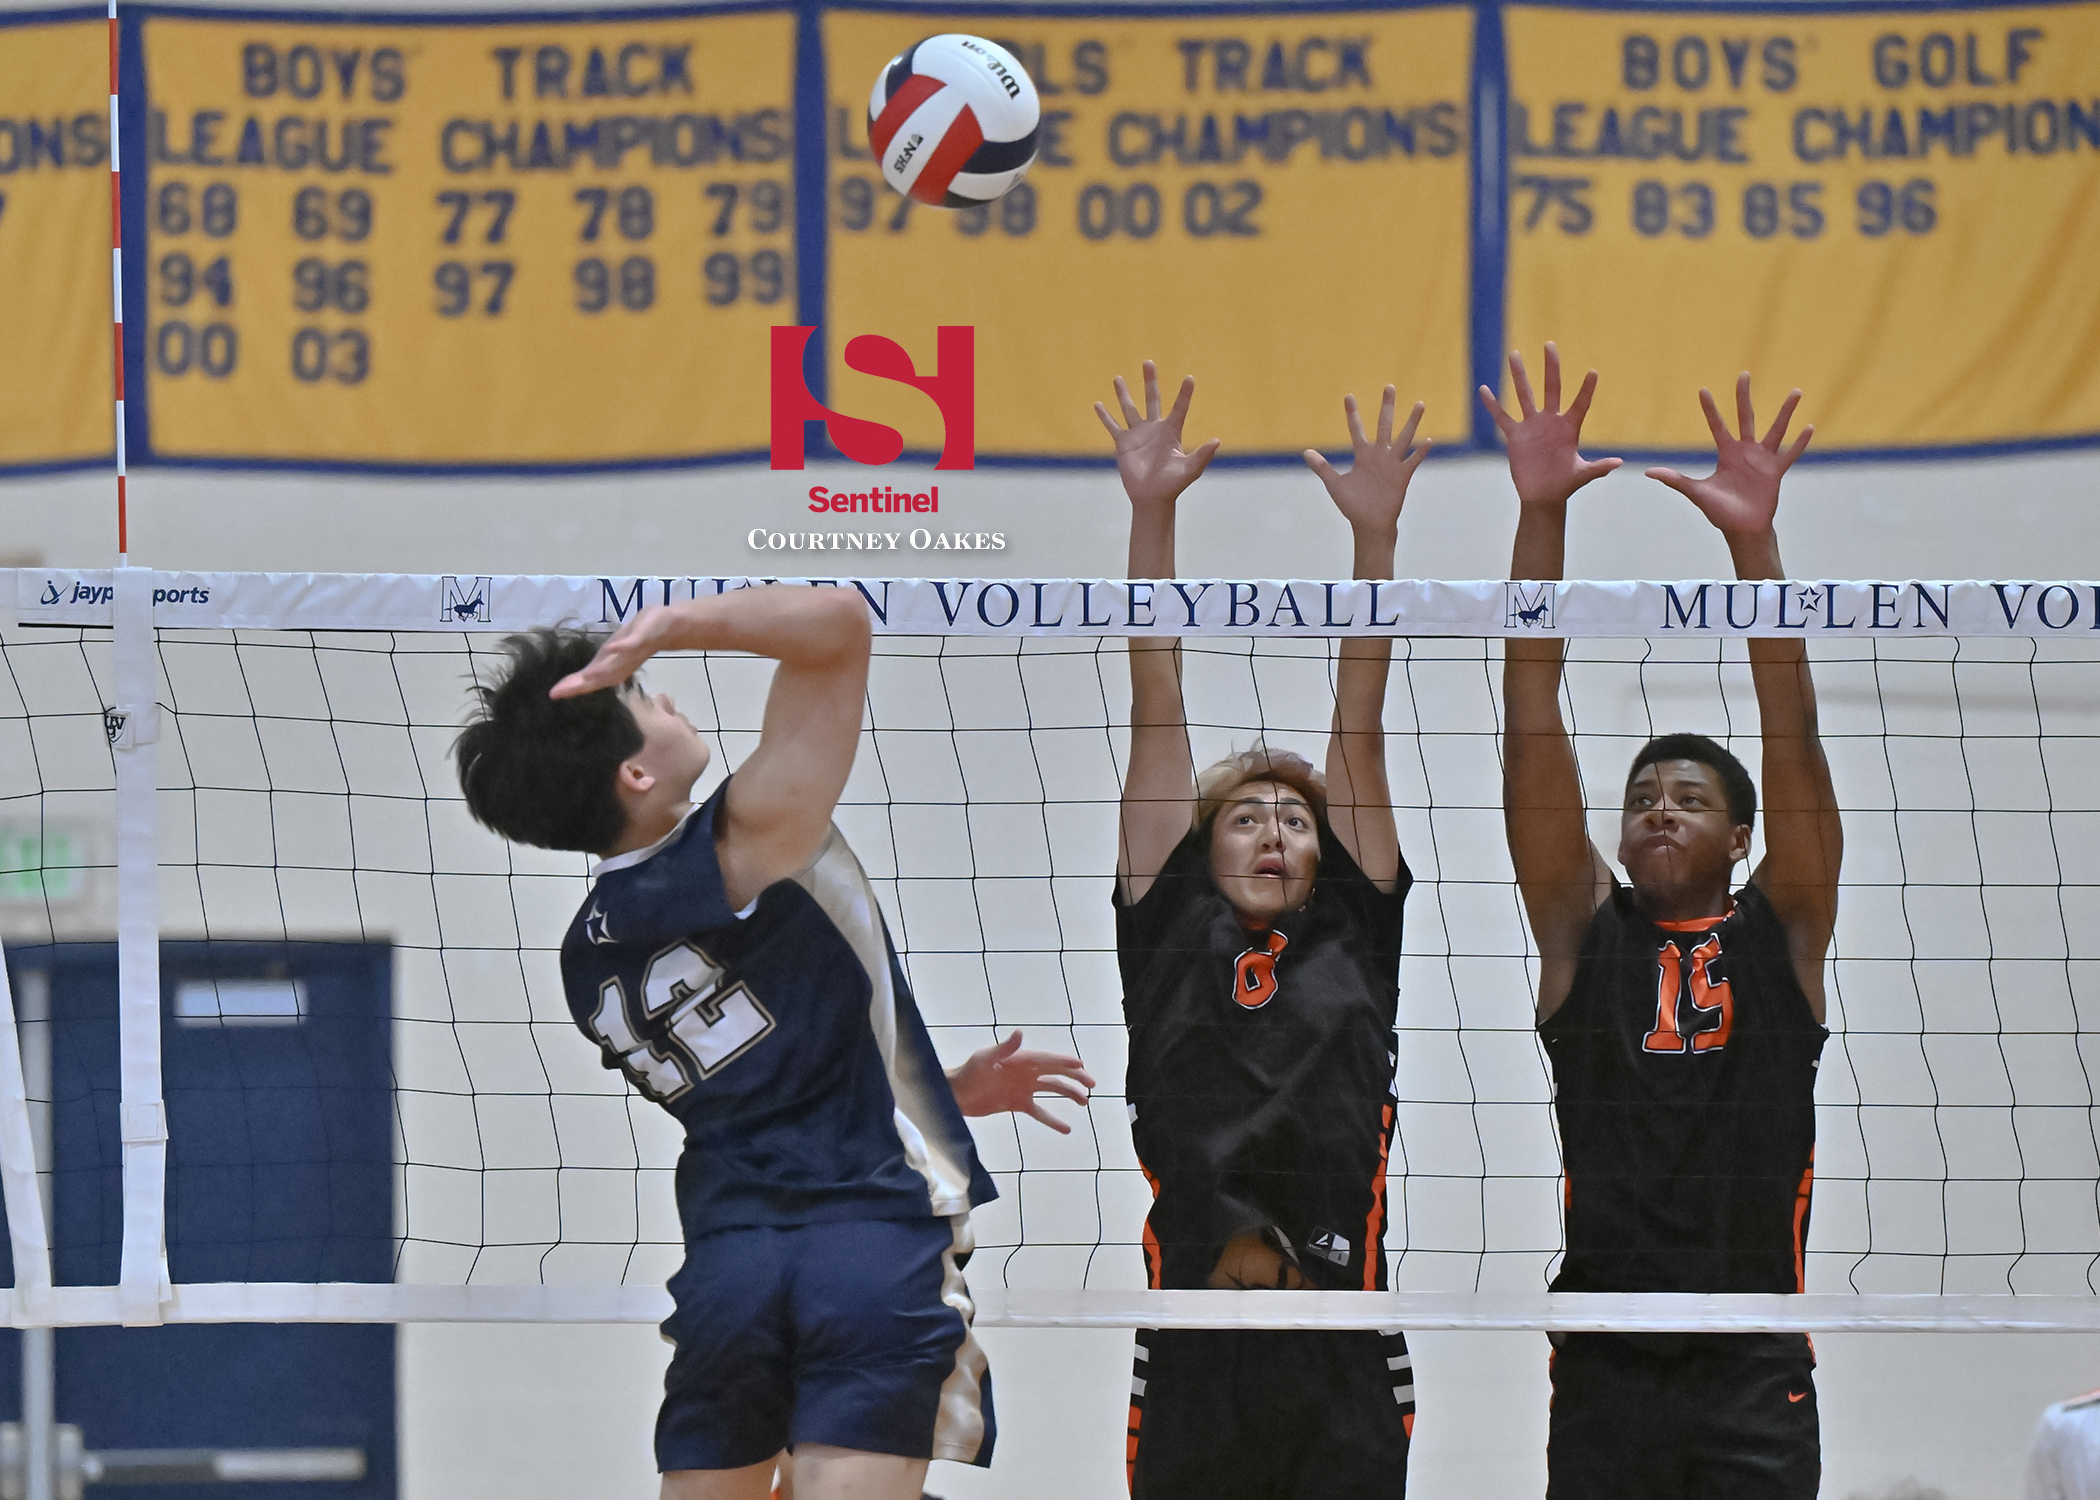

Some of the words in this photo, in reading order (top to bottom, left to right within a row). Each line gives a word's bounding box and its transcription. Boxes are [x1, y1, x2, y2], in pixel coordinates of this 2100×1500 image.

[493, 43, 693, 100] TRACK
[961, 41, 1020, 100] Wilson
[1176, 37, 1372, 94] TRACK
[1872, 27, 2043, 91] GOLF
[152, 108, 393, 174] LEAGUE
[440, 112, 789, 174] CHAMPIONS
[893, 141, 917, 174] NFHS
[1107, 102, 1460, 168] CHAMPIONS
[1512, 100, 1750, 164] LEAGUE
[1791, 98, 2100, 165] CHAMPION
[155, 181, 238, 240] 68
[292, 185, 374, 244] 69
[436, 188, 517, 246] 77
[573, 184, 655, 244] 78
[703, 180, 787, 238] 79
[1077, 182, 1163, 241] 00
[1182, 179, 1264, 238] 02
[1514, 174, 1595, 235] 75
[1630, 180, 1717, 240] 83
[1742, 180, 1827, 241] 85
[1855, 177, 1938, 238] 96
[156, 251, 235, 309] 94
[293, 257, 371, 315] 96
[433, 260, 515, 318] 97
[573, 255, 657, 315] 98
[702, 248, 787, 307] 99
[155, 318, 238, 380] 00
[291, 326, 371, 386] 03
[70, 581, 114, 605] jayp
[152, 586, 209, 607] ports
[930, 580, 1399, 628] VOLLEYBALL
[1660, 583, 1954, 630] MULLEN
[588, 937, 777, 1104] 12
[1642, 932, 1734, 1054] 15
